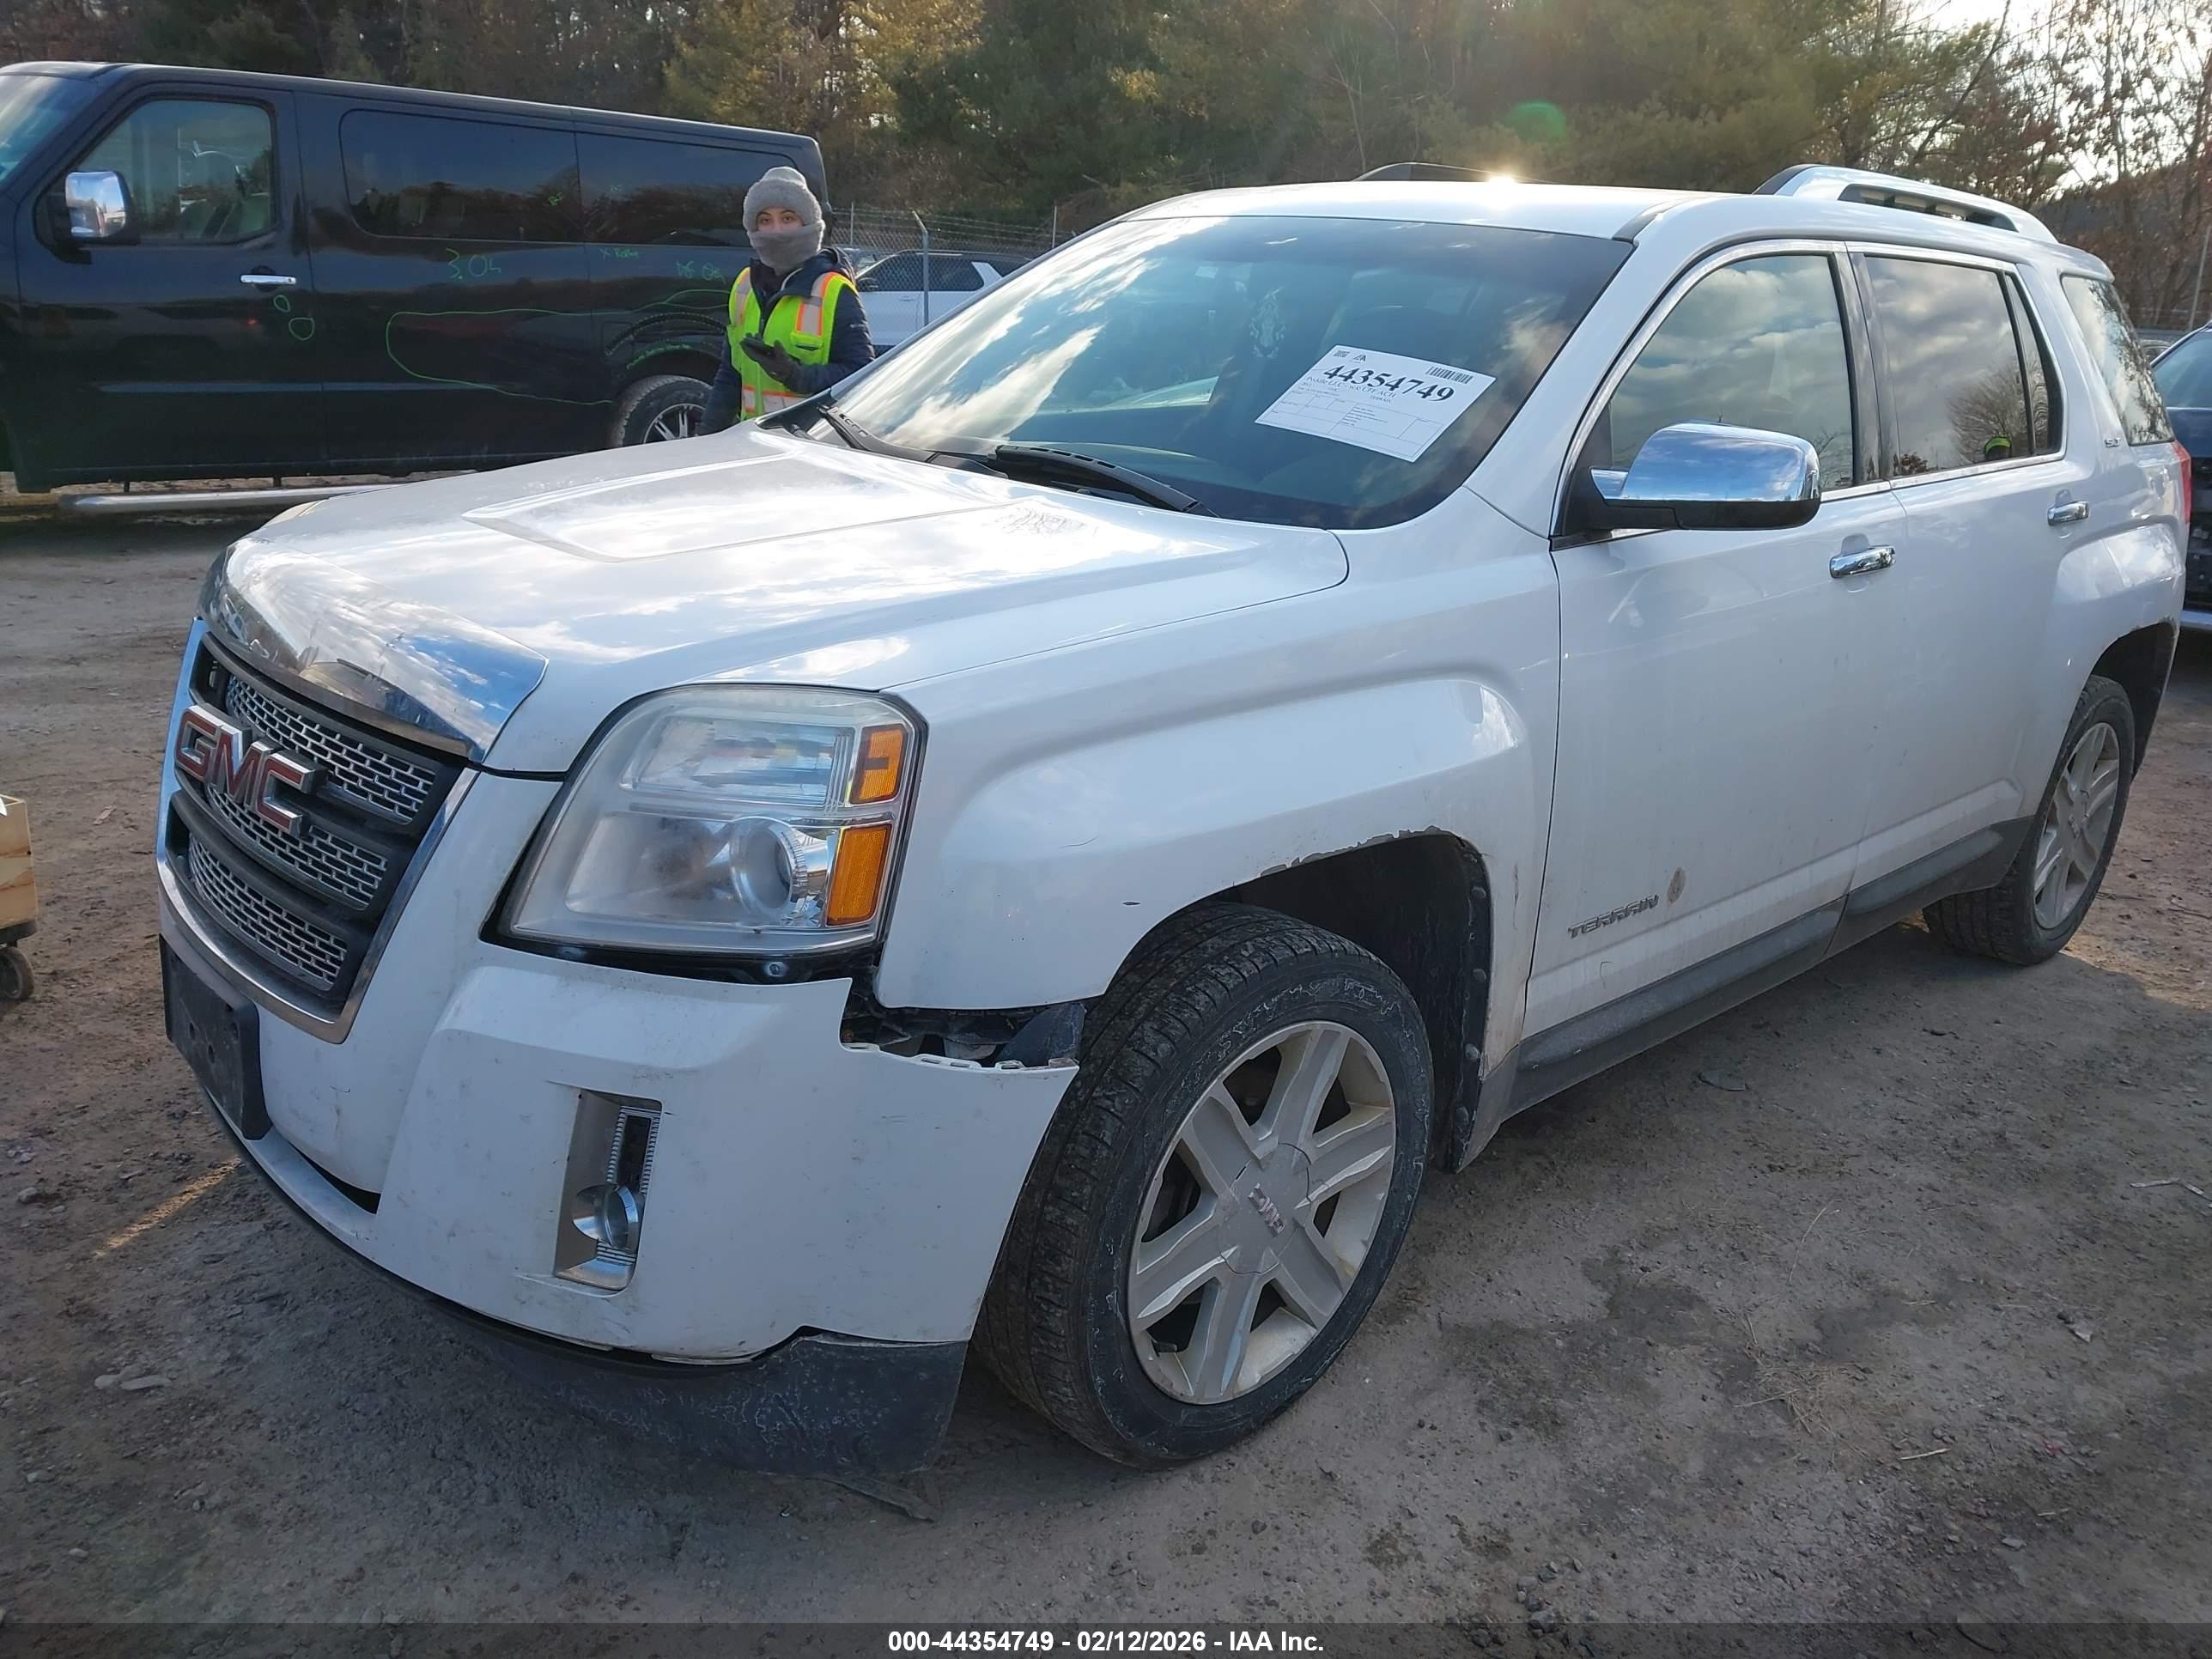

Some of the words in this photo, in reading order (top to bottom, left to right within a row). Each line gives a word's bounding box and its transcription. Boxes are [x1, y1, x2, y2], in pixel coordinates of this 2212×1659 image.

[1323, 364, 1455, 402] 44354749
[175, 705, 316, 838] GMC
[1568, 894, 1659, 939] TERRAIN
